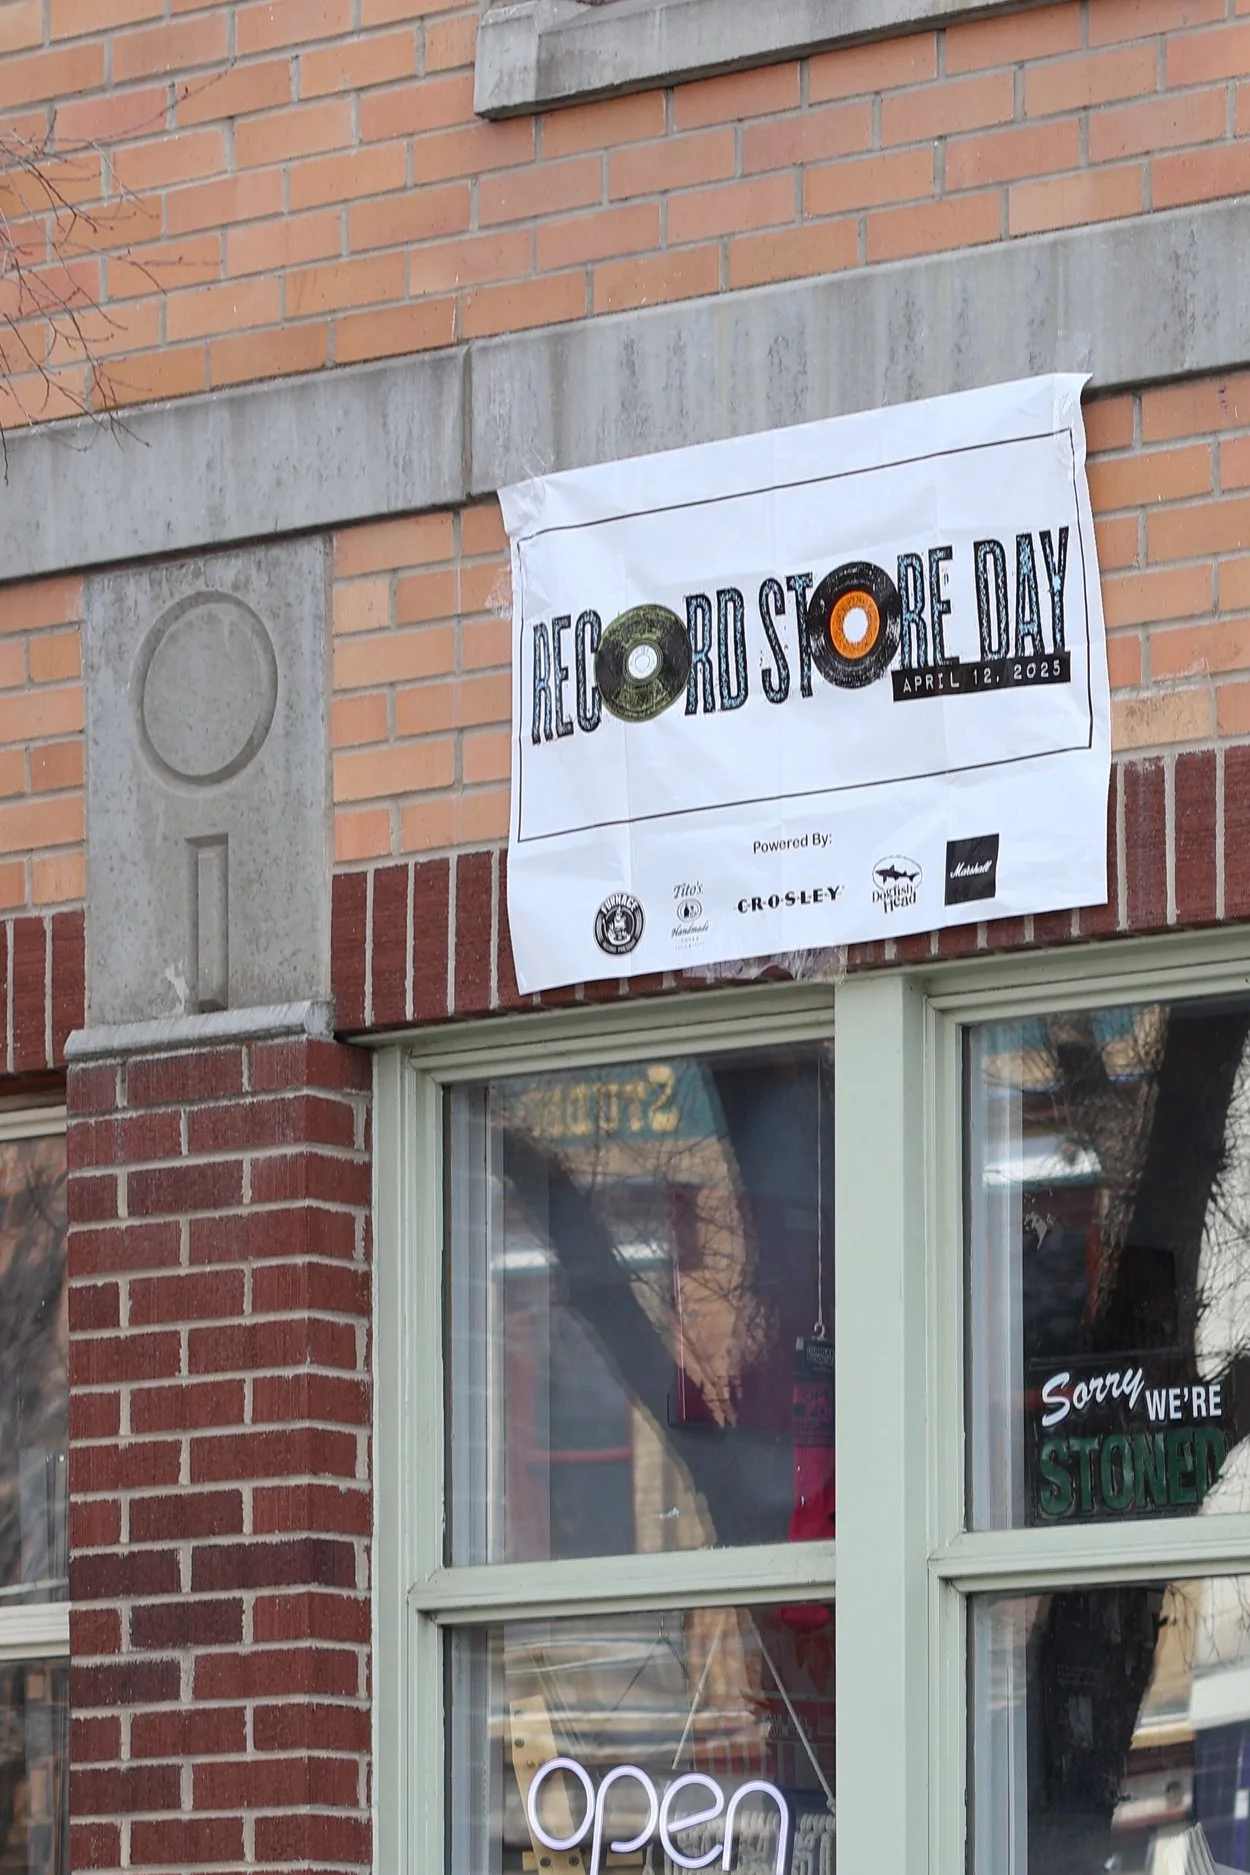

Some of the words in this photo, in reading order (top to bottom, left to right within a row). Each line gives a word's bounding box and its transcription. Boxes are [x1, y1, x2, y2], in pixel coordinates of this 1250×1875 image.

[531, 586, 749, 747] RECORD
[760, 546, 953, 705] STORE
[973, 526, 1070, 662] DAY
[903, 670, 961, 694] APRIL
[973, 668, 1001, 686] 12,
[1014, 659, 1061, 681] 2025
[753, 834, 808, 854] Powered
[812, 832, 832, 848] By:
[949, 860, 993, 879] Marshall
[672, 881, 704, 900] Tito's
[872, 884, 914, 903] Dogfish
[601, 893, 639, 914] FURNACE
[882, 890, 917, 914] Head
[671, 920, 710, 938] Handmade
[1041, 1367, 1144, 1427] Sorry
[1145, 1384, 1222, 1421] WE'RE
[1040, 1426, 1226, 1515] STONED
